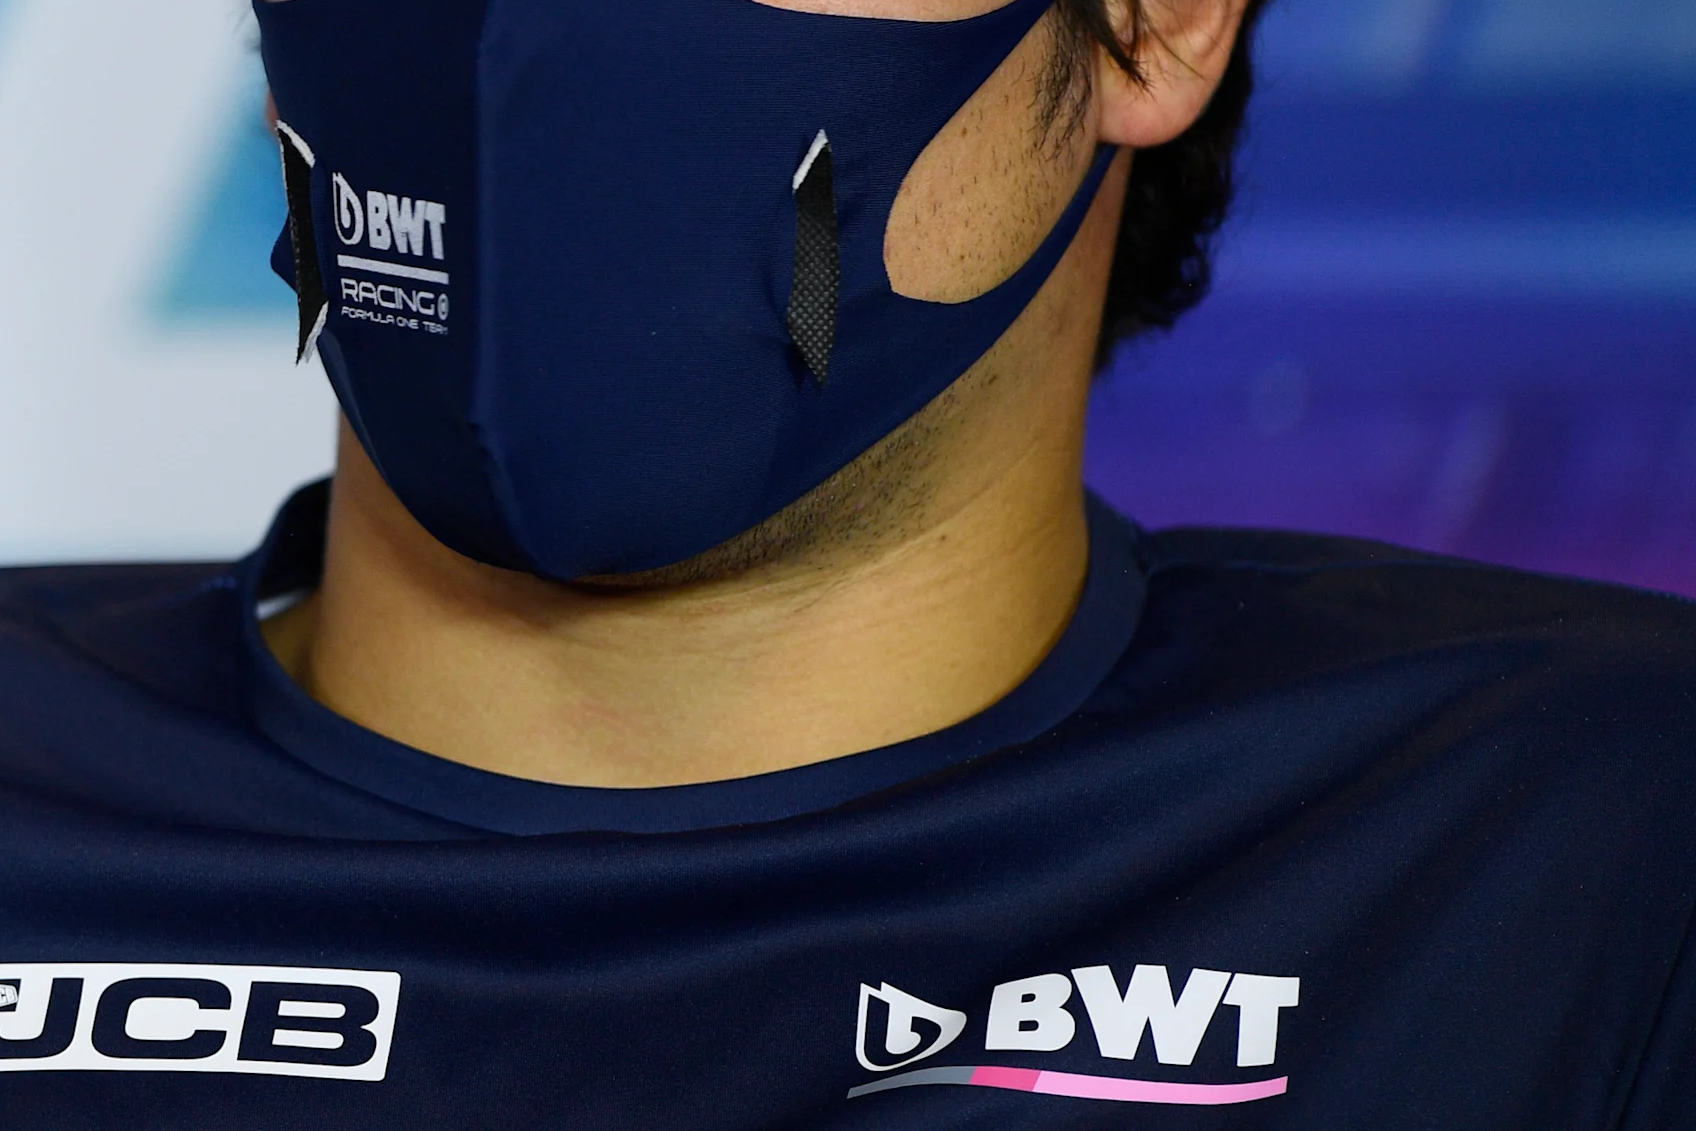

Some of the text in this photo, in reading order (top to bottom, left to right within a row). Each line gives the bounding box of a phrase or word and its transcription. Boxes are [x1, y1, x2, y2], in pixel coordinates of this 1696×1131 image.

[365, 189, 446, 260] BWT
[340, 277, 435, 316] RACING
[340, 305, 395, 326] FORMULA
[396, 316, 419, 330] ONE
[984, 963, 1301, 1068] BWT
